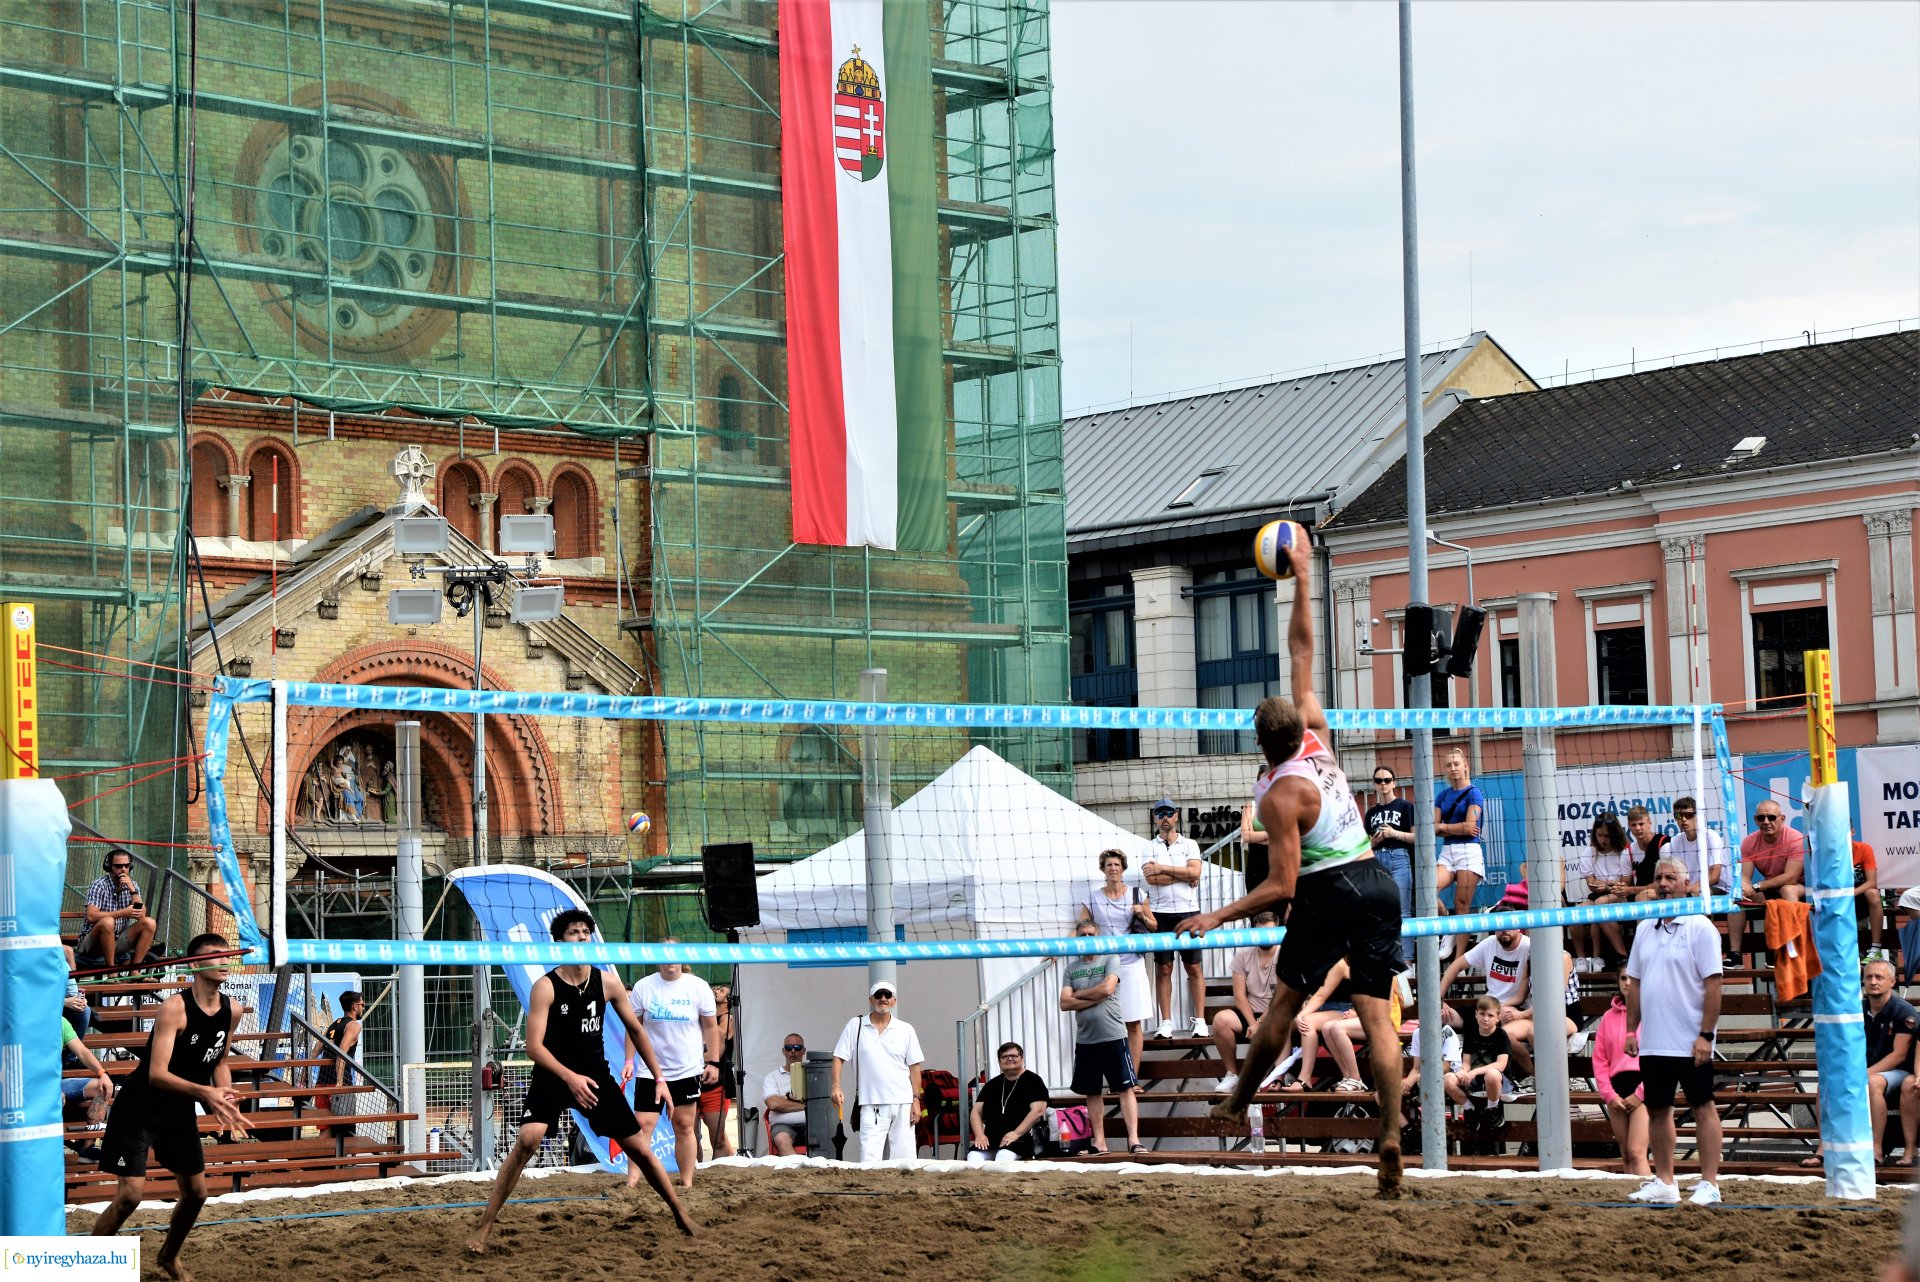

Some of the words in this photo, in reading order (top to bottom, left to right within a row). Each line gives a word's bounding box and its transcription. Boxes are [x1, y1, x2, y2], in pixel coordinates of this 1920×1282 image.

[16, 634, 34, 777] UNTEC
[1883, 781, 1920, 801] MO
[586, 1000, 597, 1017] 1
[214, 1030, 226, 1048] 2
